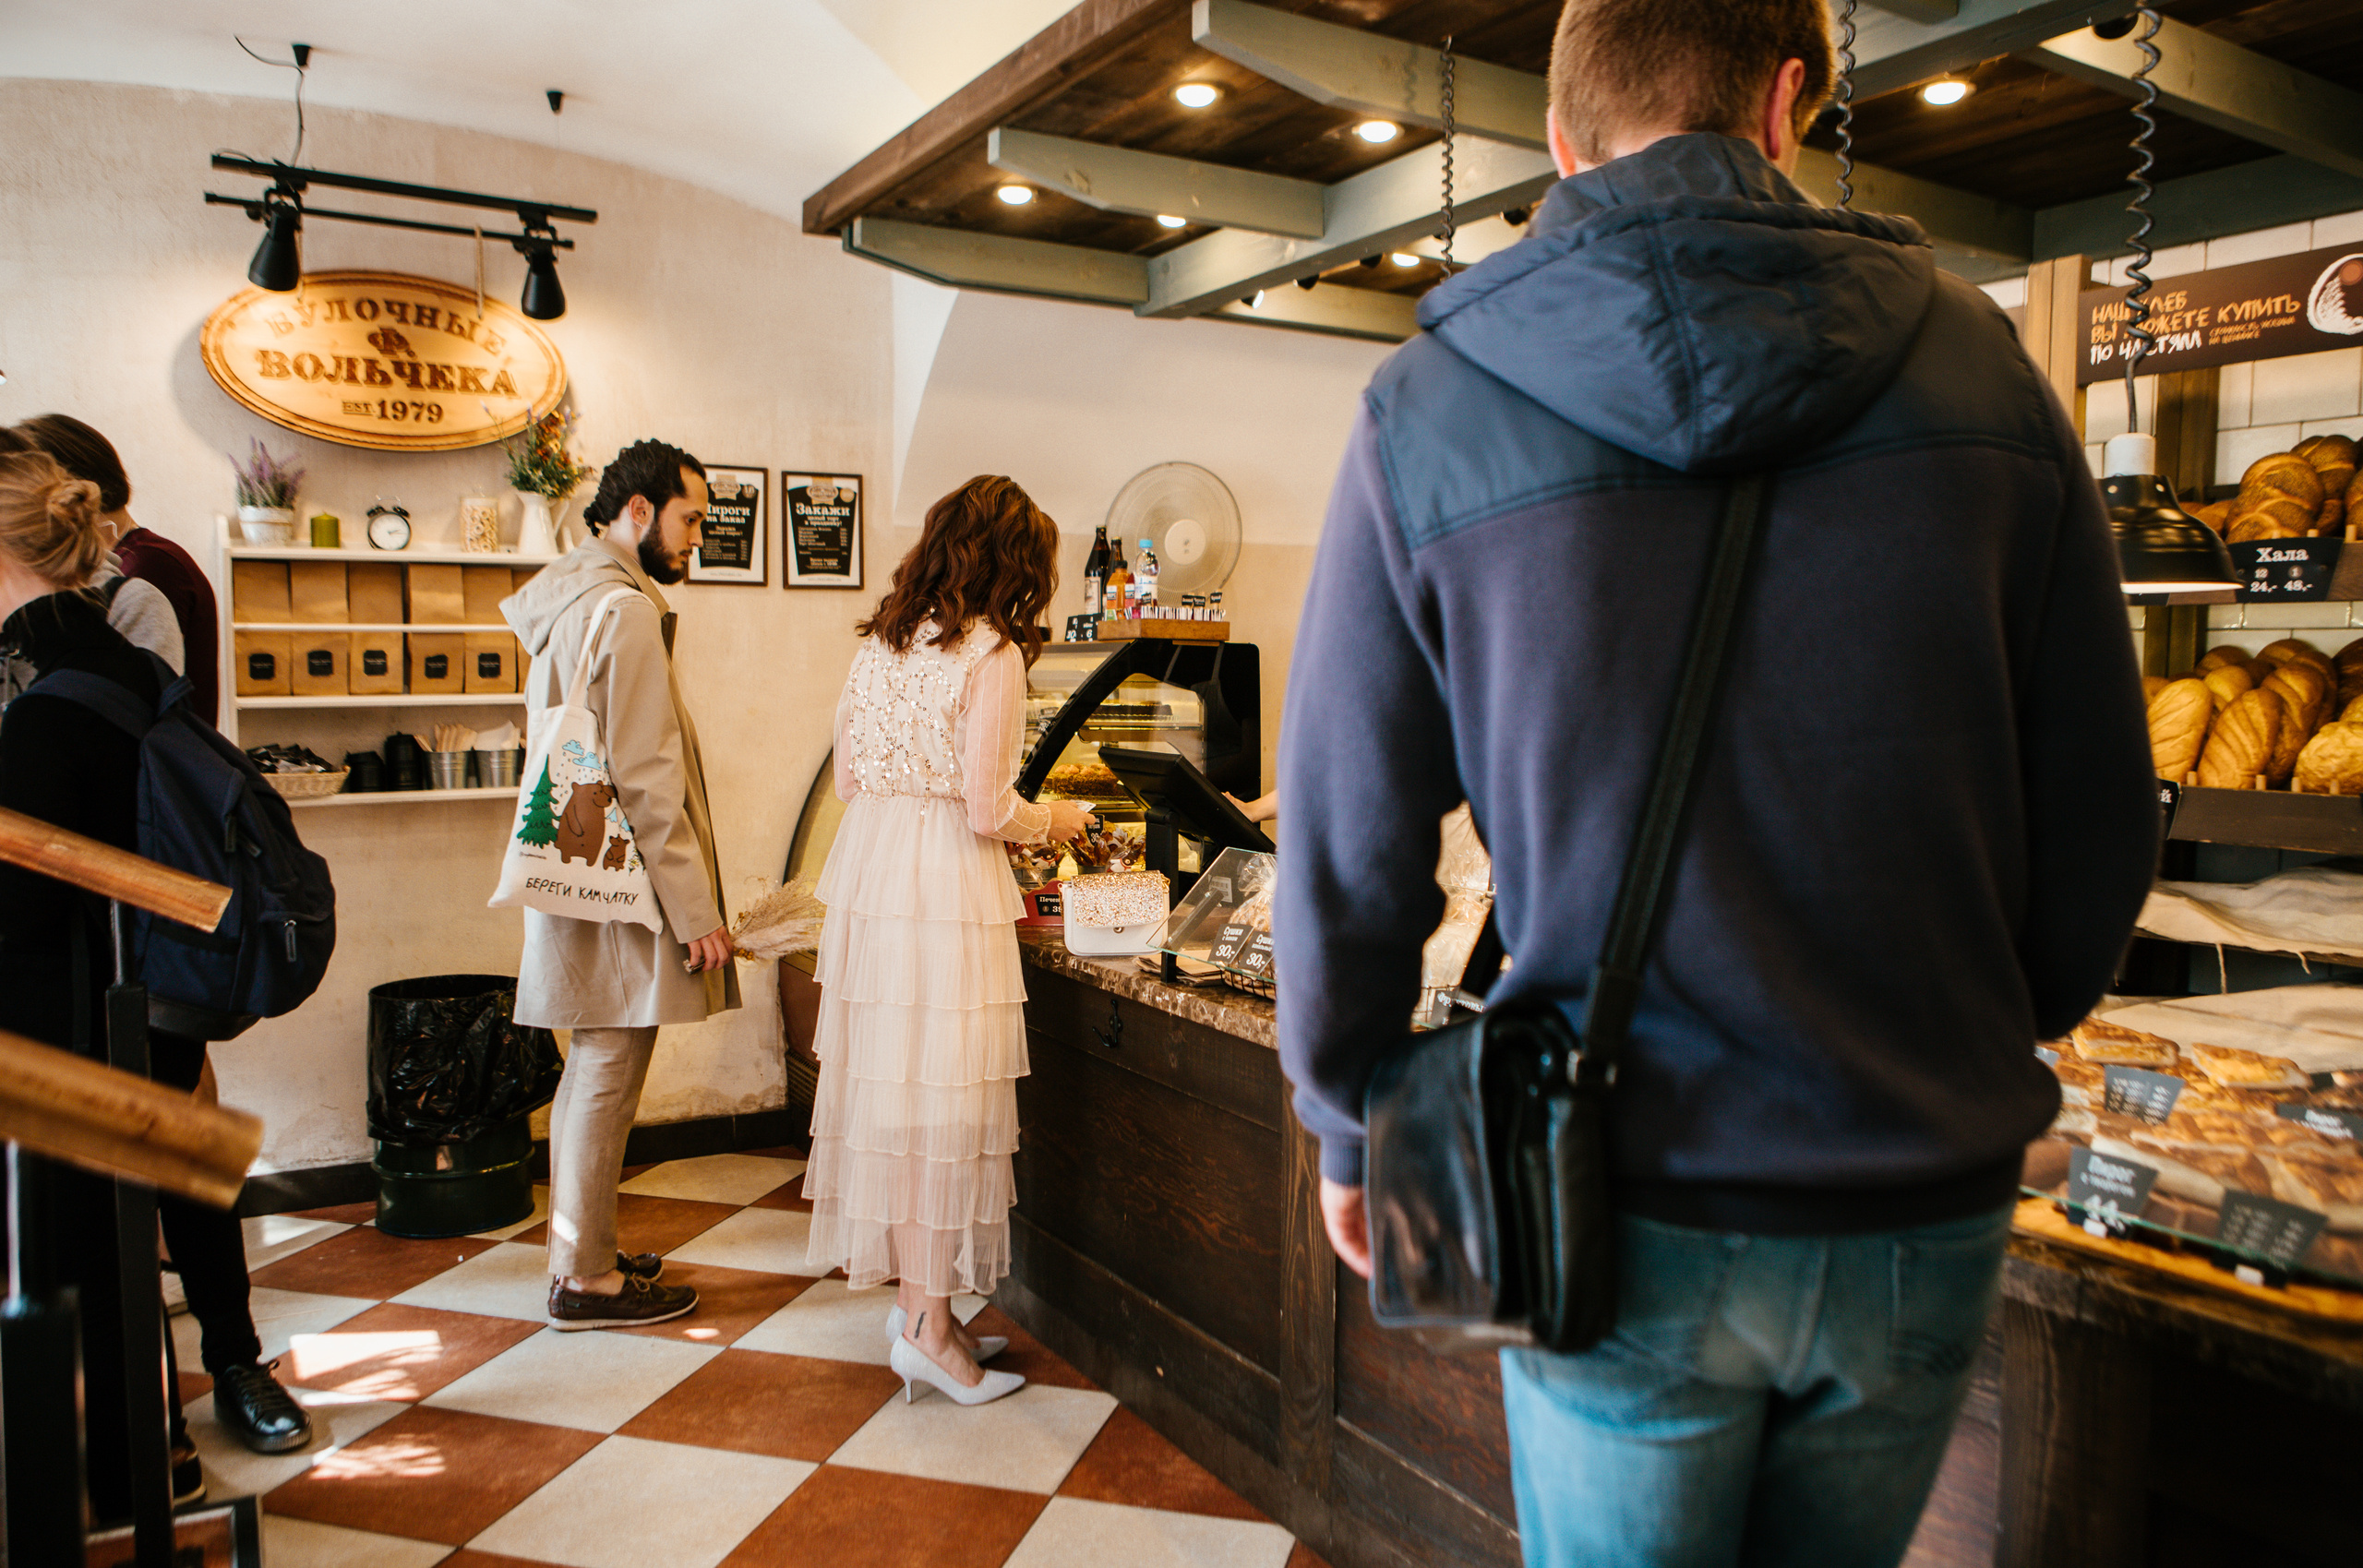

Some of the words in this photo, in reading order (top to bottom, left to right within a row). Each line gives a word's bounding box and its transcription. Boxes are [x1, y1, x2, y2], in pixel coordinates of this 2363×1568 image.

[2091, 321, 2118, 344] ВЫ
[2123, 306, 2211, 340] ОЖЕТЕ
[2217, 293, 2301, 323] КУПИТЬ
[2092, 300, 2131, 325] НАШ
[2136, 290, 2188, 317] ЛЕБ
[264, 298, 510, 356] БУЛОЧНЫЕ
[2090, 343, 2115, 365] ПО
[258, 349, 522, 399] ВОЛЬЧЕКА
[377, 400, 444, 424] 1979
[795, 502, 850, 517] Закажи
[2255, 546, 2309, 563] Хала
[525, 877, 572, 897] БЕРЕГИ
[579, 886, 640, 905] КАМЧАТКУ
[1216, 944, 1235, 959] 30,-
[1246, 952, 1265, 969] 30,-
